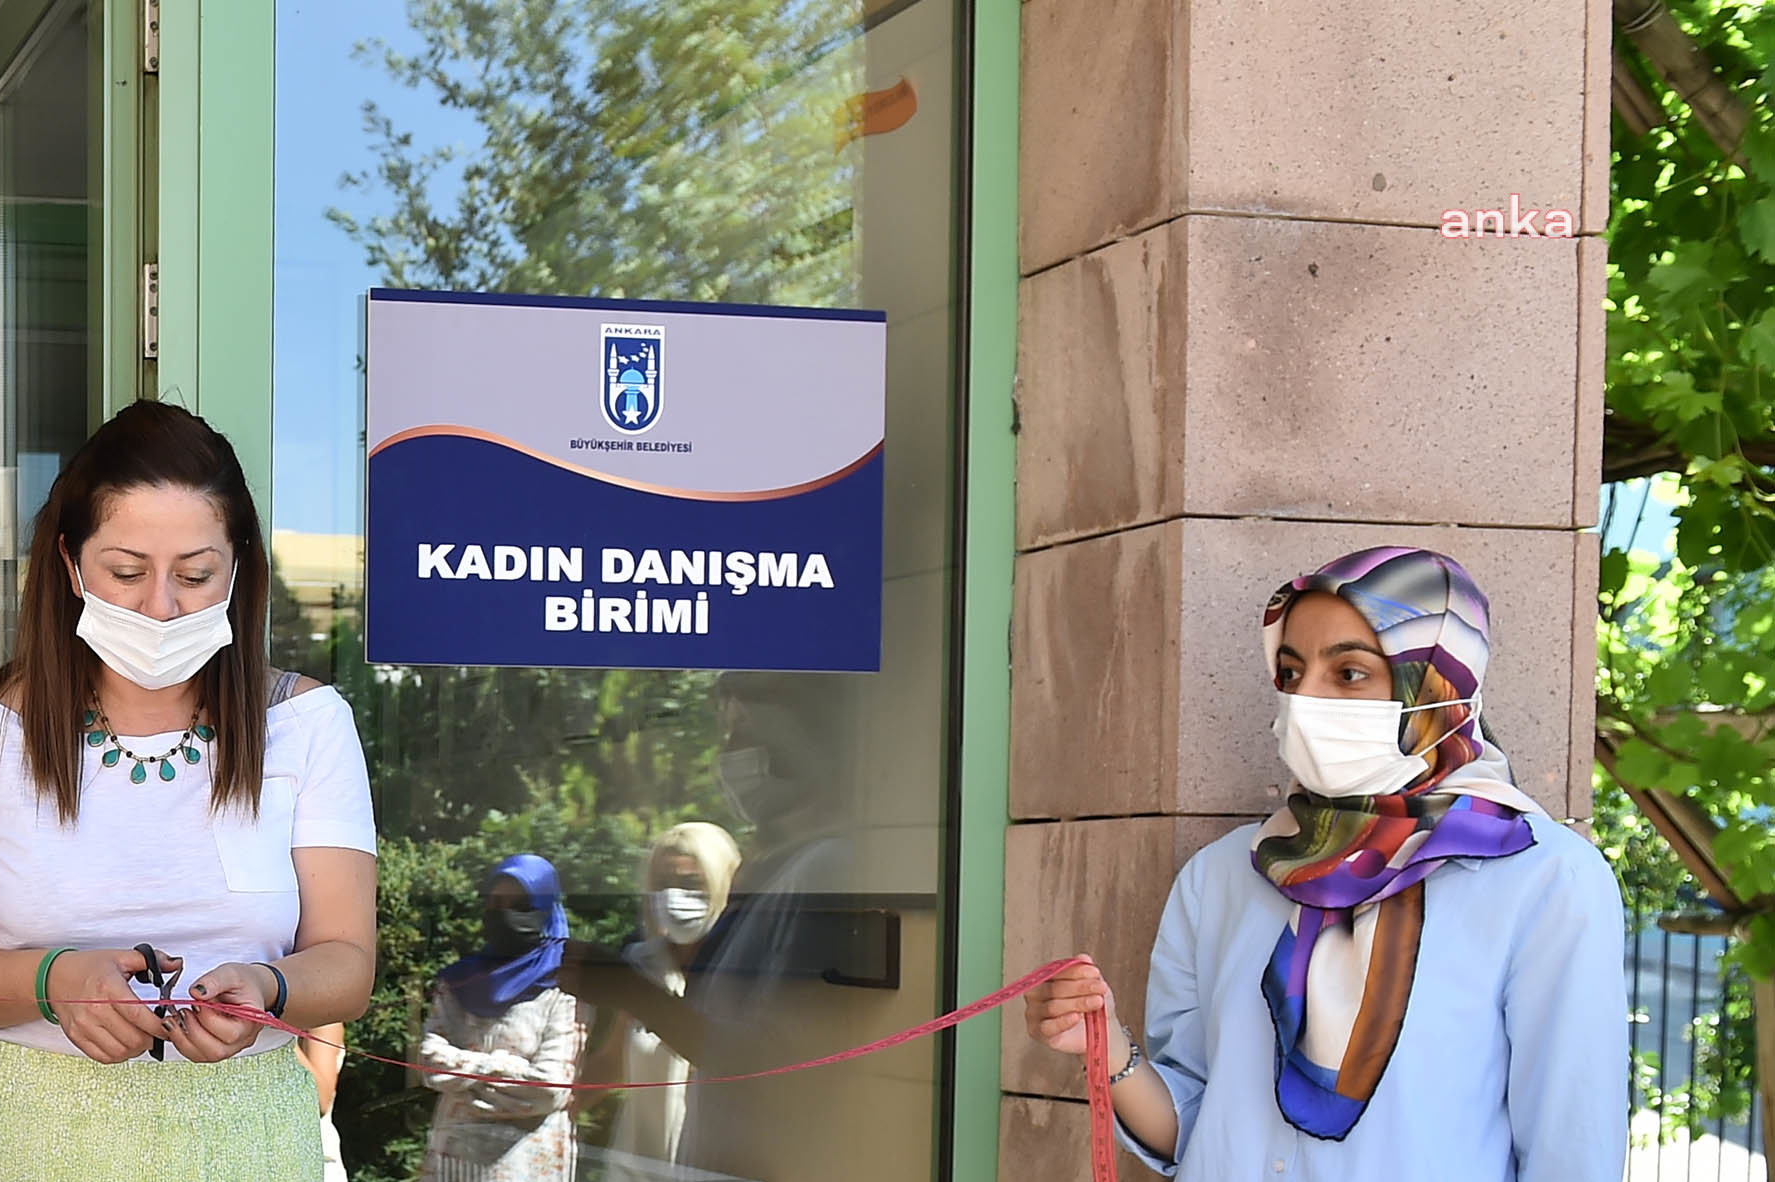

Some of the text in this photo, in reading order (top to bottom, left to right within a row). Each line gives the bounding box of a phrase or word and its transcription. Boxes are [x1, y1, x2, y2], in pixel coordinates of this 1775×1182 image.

[604, 327, 661, 336] ANKARA
[570, 438, 692, 453] BÜYÜKŞEHİR BELEDİYESİ
[418, 543, 835, 596] KADIN DANIŞMA
[544, 588, 710, 634] BİRİMİ
